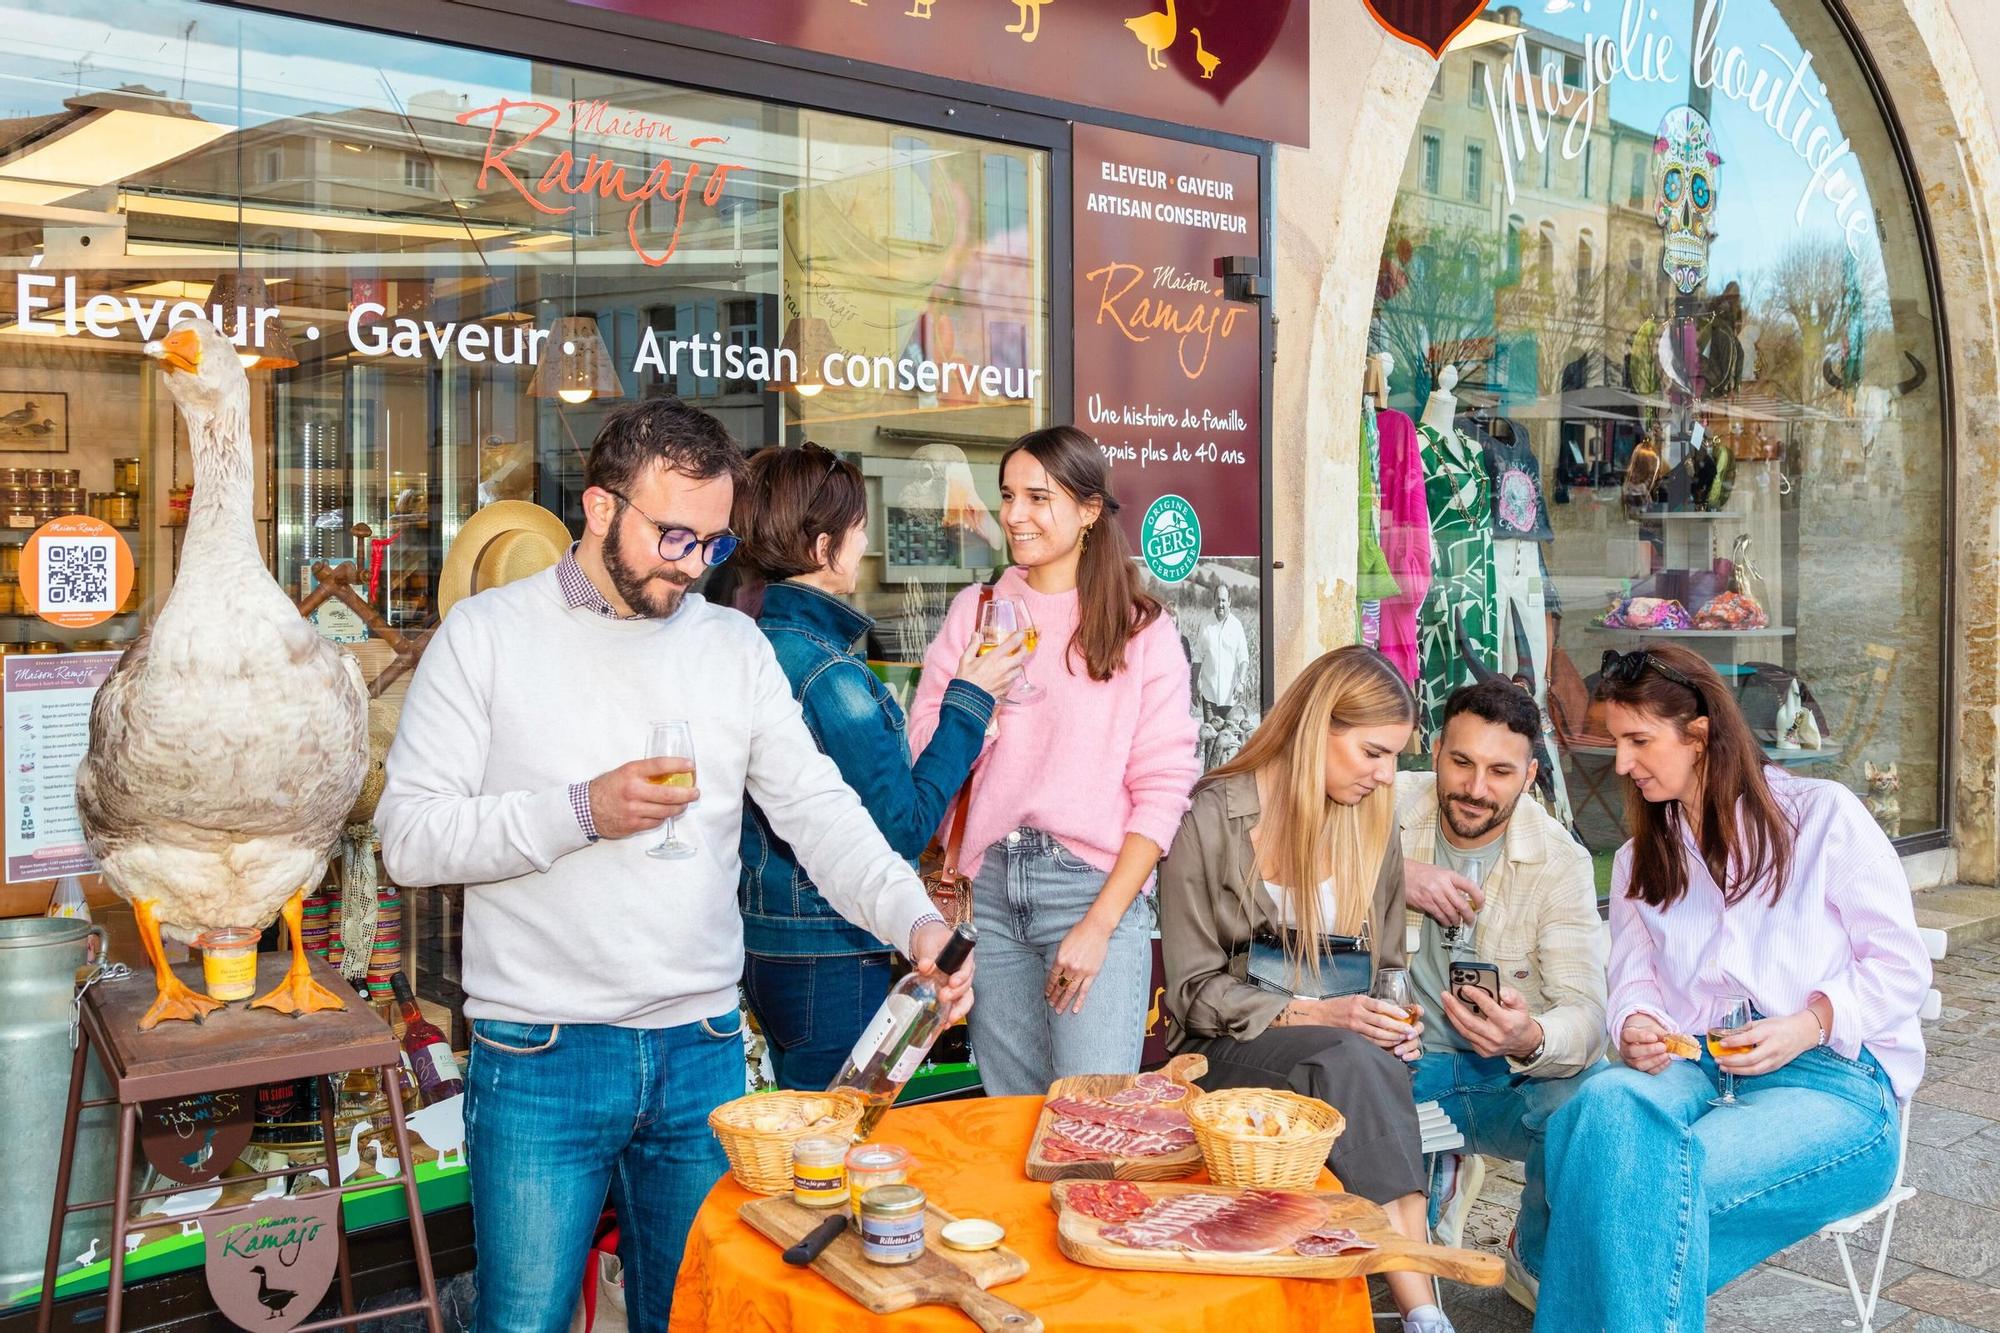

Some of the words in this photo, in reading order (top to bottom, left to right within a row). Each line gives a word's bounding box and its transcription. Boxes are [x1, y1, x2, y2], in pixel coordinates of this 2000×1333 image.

[569, 99, 679, 142] Maison
[1484, 33, 1578, 206] Ma
[1561, 0, 1680, 160] jolie
[1693, 0, 1873, 262] boutique
[1101, 161, 1167, 190] ELEVEUR
[1177, 175, 1234, 201] GAVEUR
[1086, 193, 1152, 219] ARTISAN
[1155, 203, 1247, 234] CONSERVEUR
[1153, 265, 1211, 294] Maison
[347, 302, 551, 365] Gaveur
[633, 325, 797, 382] Artisan
[823, 351, 1041, 399] conserveur
[1088, 393, 1121, 424] Une
[1124, 404, 1179, 428] histoire
[1181, 409, 1200, 428] de
[1202, 409, 1247, 432] famille
[1095, 438, 1137, 467] epuis
[1141, 439, 1169, 468] plus
[1172, 442, 1192, 462] de
[1195, 442, 1218, 463] 40
[1221, 449, 1246, 465] ans
[1148, 500, 1189, 526] ORIGINE
[1147, 528, 1197, 558] GERS
[14, 668, 54, 681] Maison
[879, 1235, 907, 1245] Rillettes
